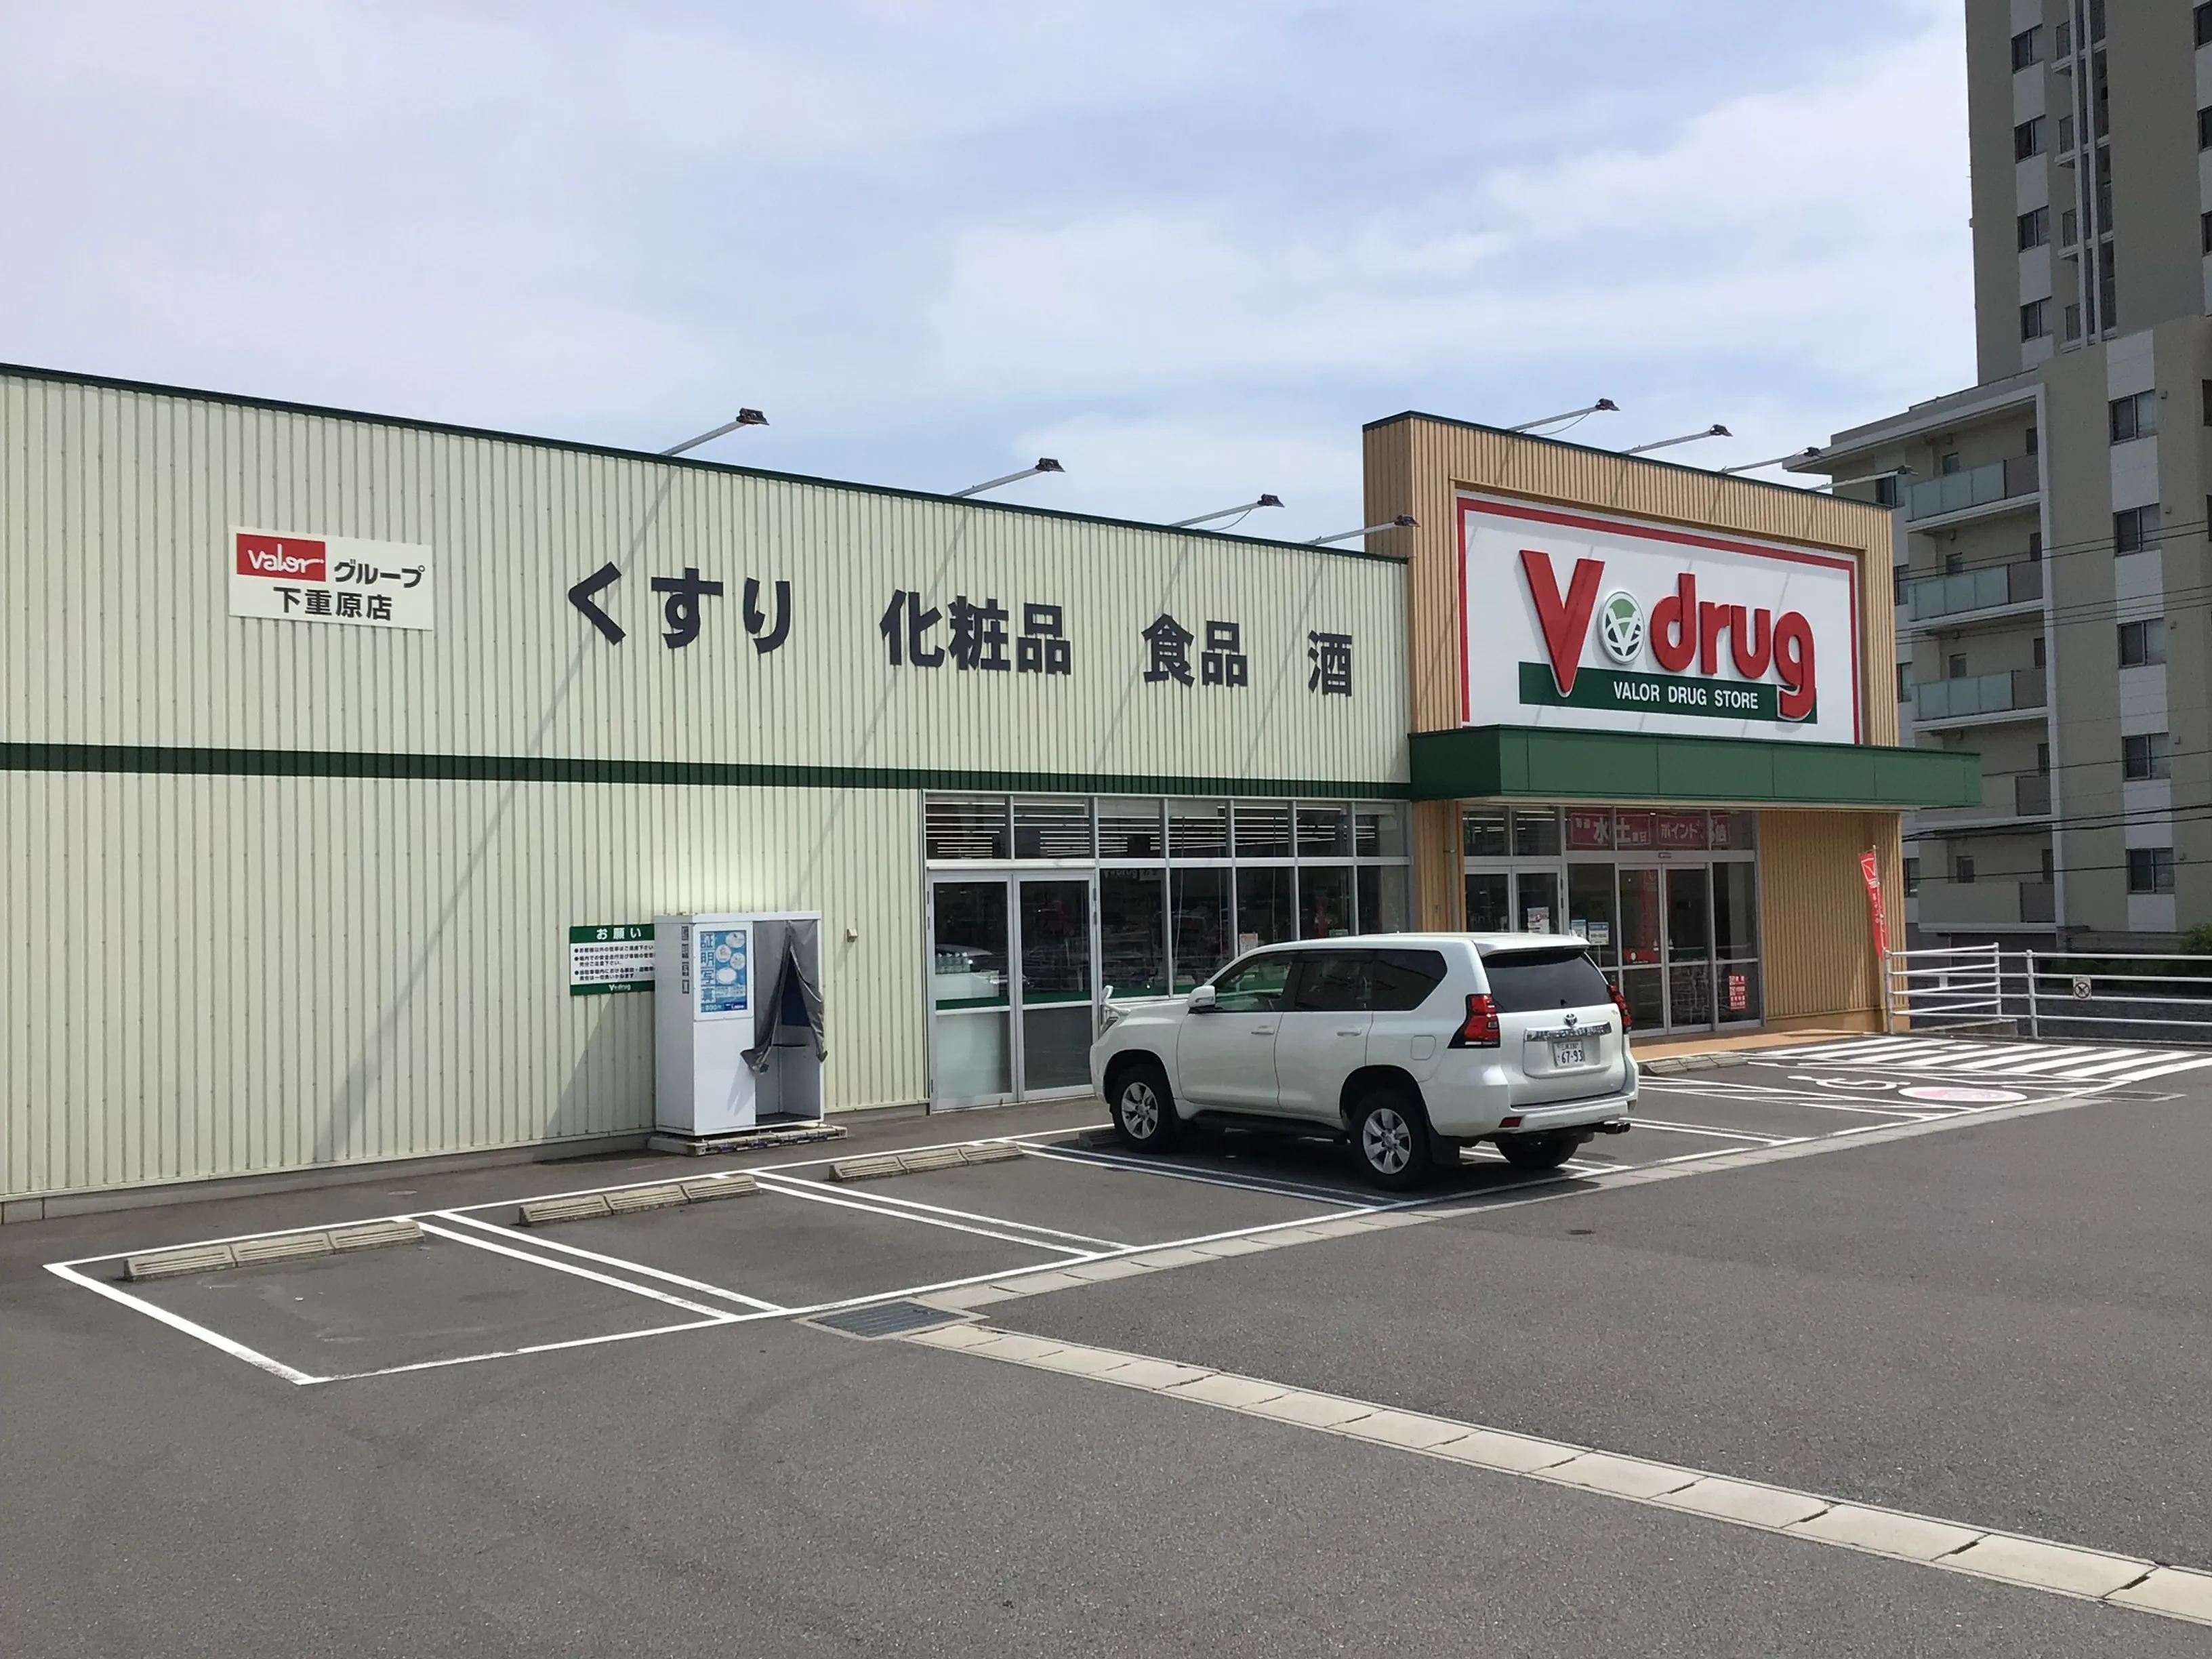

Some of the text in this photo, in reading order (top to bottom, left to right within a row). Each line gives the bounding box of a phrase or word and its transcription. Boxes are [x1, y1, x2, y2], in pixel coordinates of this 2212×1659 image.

[333, 558, 426, 589] グループ
[272, 586, 392, 621] 下重原店
[568, 561, 1353, 697] くすり 化粧品 食品 酒
[1613, 680, 1759, 710] VALOR DRUG STORE
[596, 927, 642, 940] お願い
[1561, 1050, 1583, 1064] 67-93
